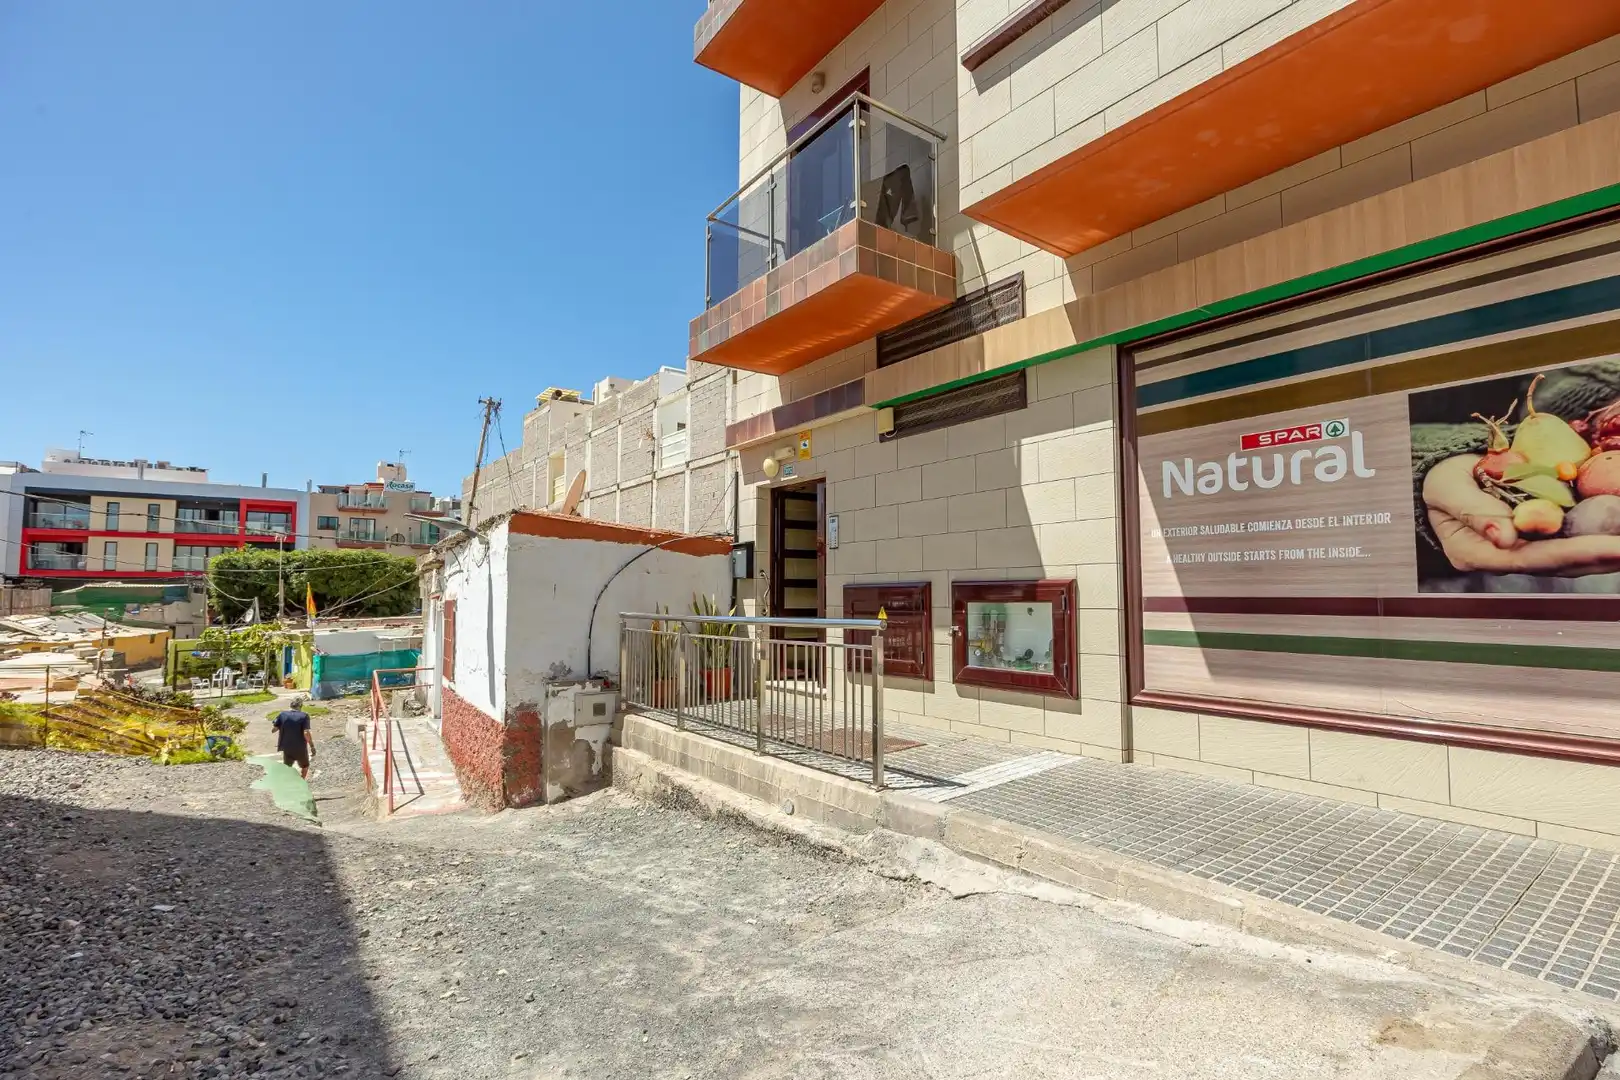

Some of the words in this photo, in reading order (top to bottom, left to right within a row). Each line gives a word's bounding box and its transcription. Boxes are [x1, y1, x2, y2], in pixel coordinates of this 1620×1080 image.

[1258, 426, 1321, 446] SPAR
[1162, 431, 1376, 498] Natural
[1163, 526, 1198, 537] EXTERIOR
[1200, 523, 1245, 535] SALUDABLE
[1247, 519, 1293, 533] COMIENZA
[1295, 517, 1325, 529] DESDE
[1328, 516, 1341, 527] EL
[1342, 512, 1392, 526] INTERIOR
[1173, 553, 1206, 564] HEALTHY
[1208, 551, 1241, 562] OUTSIDE
[1244, 549, 1277, 561] STARTS
[1279, 548, 1305, 560] FROM
[1307, 547, 1326, 559] THE
[1328, 546, 1372, 558] INSIDE...
